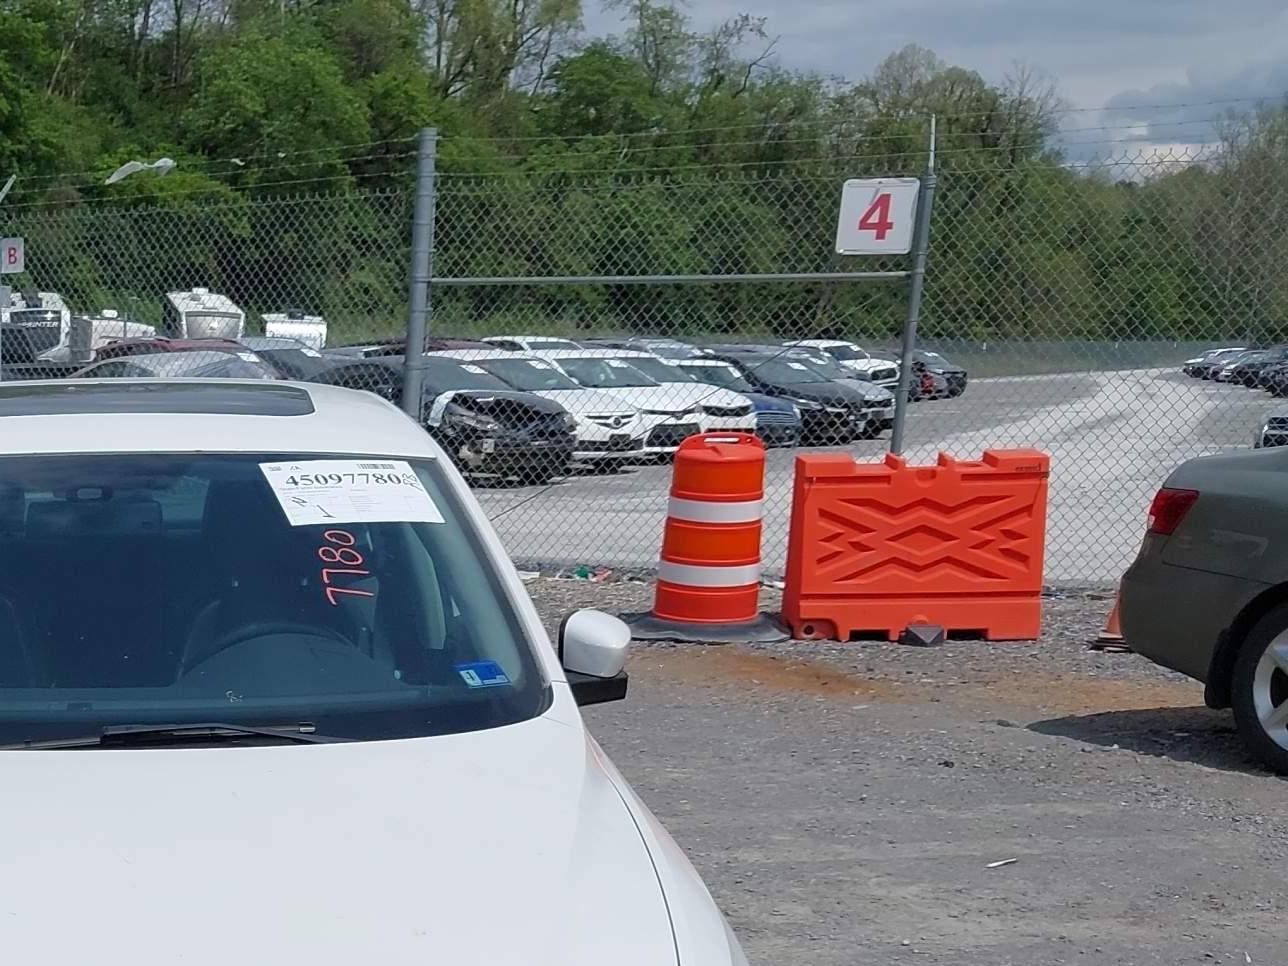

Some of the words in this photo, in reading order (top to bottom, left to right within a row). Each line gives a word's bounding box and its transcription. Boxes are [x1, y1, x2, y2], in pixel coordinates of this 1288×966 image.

[858, 193, 894, 240] 4
[7, 247, 18, 265] B
[285, 473, 402, 487] 45097780
[318, 529, 375, 606] 7780
